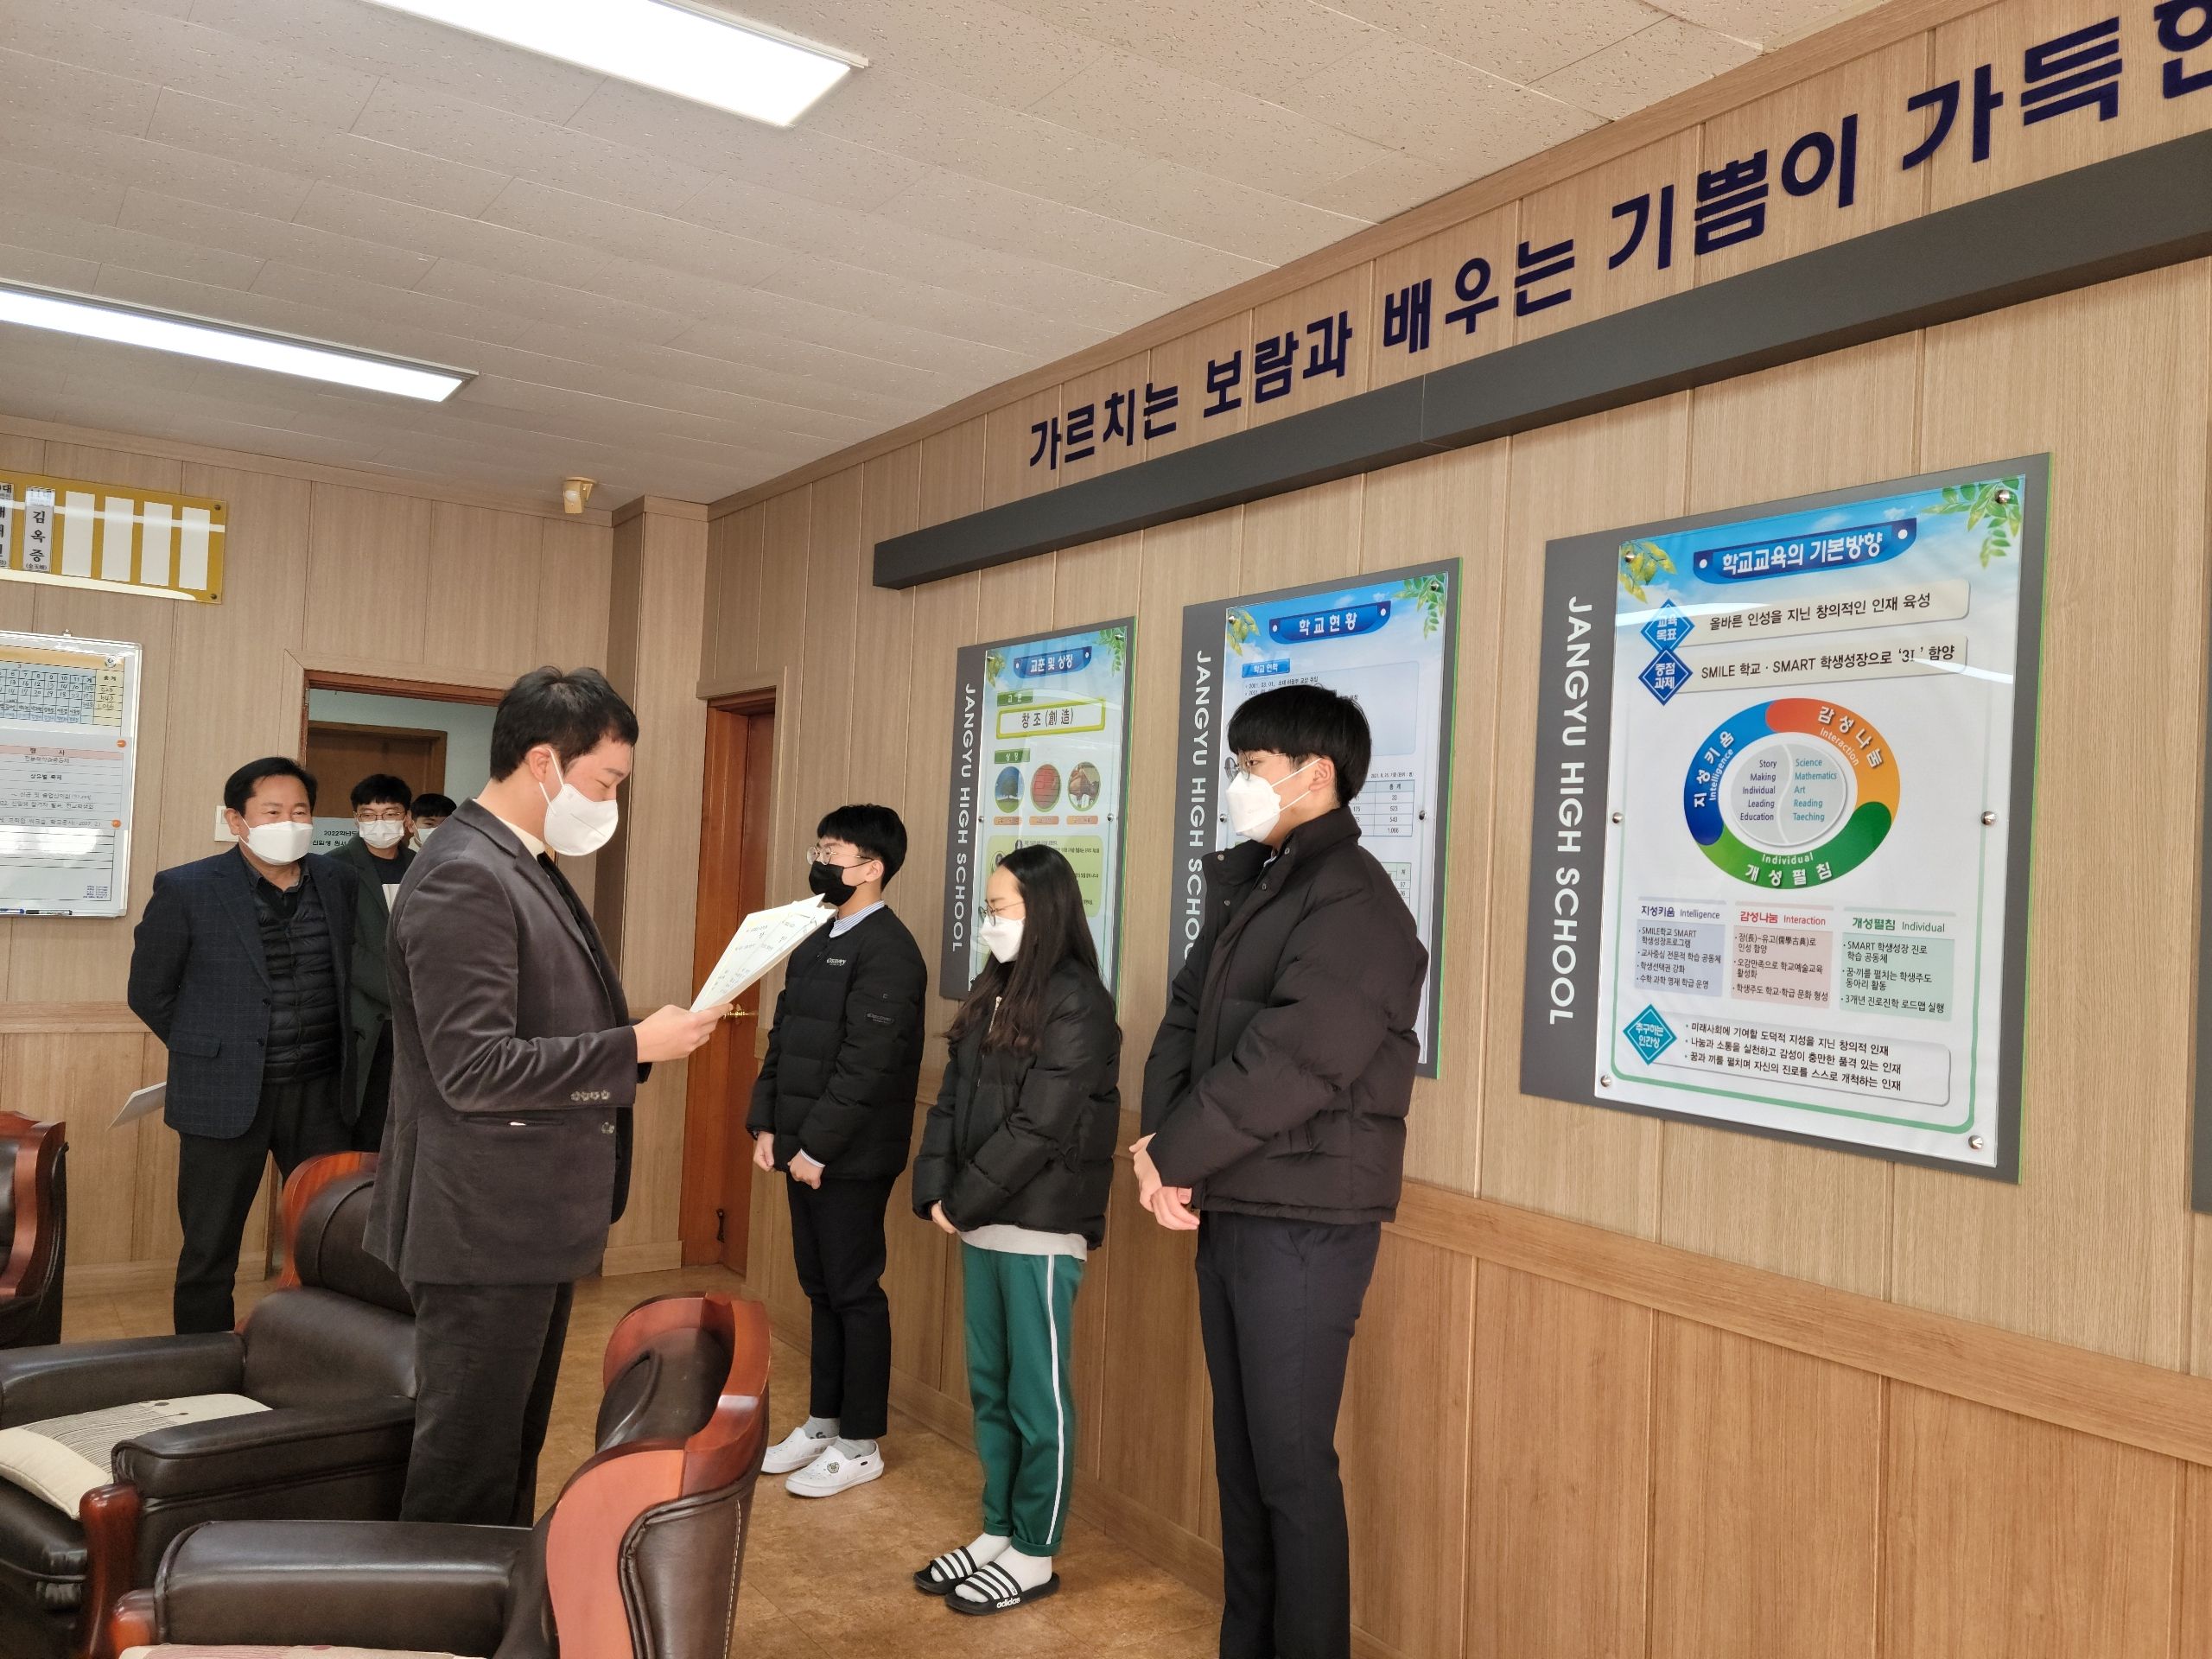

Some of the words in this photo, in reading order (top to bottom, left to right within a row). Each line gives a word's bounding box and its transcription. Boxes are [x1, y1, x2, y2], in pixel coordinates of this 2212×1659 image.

[1030, 383, 1178, 470] 가르치는
[1204, 310, 1352, 418] 보람과
[1383, 238, 1574, 353] 배우는
[1608, 114, 1858, 270] 기쁨이
[1722, 543, 1804, 575] 학교교육의
[1809, 531, 1883, 563] 기본방향
[1710, 614, 1743, 631] 올바른
[1747, 609, 1783, 626] 인성을
[1787, 607, 1811, 622] 지닌
[1816, 601, 1866, 620] 창의적인
[1872, 596, 1898, 613] 인재
[1903, 593, 1930, 609] 육성
[1299, 612, 1357, 636] 학교현황
[1656, 628, 1677, 641] 목표
[1048, 657, 1055, 671] 및
[1058, 653, 1073, 669] 상징
[1701, 665, 1735, 679] SMILE
[1739, 662, 1761, 677] 학교
[1772, 658, 1816, 673] SMART
[1821, 651, 1892, 670] 학생성장으로
[1929, 645, 1955, 661] 함양
[1562, 596, 1592, 747] JANGYU
[1656, 662, 1675, 677] 중점
[1654, 677, 1675, 690] 과제
[1192, 651, 1211, 766] JANGYU
[961, 683, 976, 779] JANGYU
[1818, 706, 1884, 768] 감성나눔
[1820, 728, 1859, 766] Interaction
[1694, 731, 1735, 808] 지성키움
[1759, 760, 1777, 769] Story
[1796, 758, 1823, 767] Science
[1709, 748, 1733, 801] Intelligence
[1750, 772, 1777, 782] Making
[1795, 772, 1837, 780] Mathematics
[1742, 785, 1776, 794] Individual
[1794, 785, 1805, 794] Art
[1557, 762, 1584, 853] HIGH
[1748, 799, 1775, 809] Leading
[1794, 799, 1823, 808] Reading
[957, 786, 970, 845] HIGH
[1189, 778, 1206, 848] HIGH
[1740, 812, 1774, 821] Education
[1793, 813, 1825, 823] Taeching
[1762, 852, 1814, 864] Individual
[1745, 862, 1832, 887] 개성펼침
[952, 854, 967, 952] SCHOOL
[1184, 858, 1202, 961] SCHO
[1641, 906, 1675, 918] 지성키움
[1680, 909, 1720, 919] Intelligence
[1740, 911, 1778, 924] 감성나눔
[1783, 915, 1826, 925] Interaction
[1642, 927, 1672, 936] SMILE학교
[1853, 918, 1896, 931] 개성펼침
[1902, 922, 1945, 932] Individual
[1549, 867, 1580, 1025] SCHOOL
[1642, 936, 1691, 948] 학생성장프로그램
[1738, 943, 1751, 953] 인성
[1754, 944, 1767, 954] 함양
[1847, 941, 1875, 950] SMART
[1878, 942, 1909, 954] 학생성장
[1911, 945, 1928, 955] 진로
[1641, 950, 1665, 959] 교사중심
[1667, 950, 1686, 960] 전문적
[1688, 952, 1700, 962] 학습
[1701, 954, 1721, 964] 공동체
[1847, 951, 1862, 962] 학습
[1864, 952, 1888, 963] 공동체
[1641, 962, 1671, 973] 학생선택권
[1673, 964, 1685, 974] 강화
[1738, 958, 1778, 969] 오감만족으로
[1780, 961, 1823, 974] 학교예술교육
[1653, 976, 1666, 984] 과학
[1737, 968, 1758, 979] 활성화
[1873, 969, 1897, 981] 펼치는
[1899, 971, 1932, 983] 학생주도
[1846, 978, 1869, 989] 동아리
[1872, 980, 1887, 991] 활동
[1737, 983, 1764, 994] 학생주도
[1797, 989, 1812, 1001] 문화
[1814, 990, 1828, 1001] 형성
[1845, 995, 1866, 1006] 3개년
[1868, 996, 1899, 1008] 진로진학
[1901, 1000, 1925, 1012] 로드맵
[1928, 1001, 1944, 1014] 실행
[1691, 1022, 1731, 1035] 미래사회에
[1733, 1027, 1758, 1038] 기여할
[1760, 1031, 1786, 1043] 도덕적
[1789, 1034, 1815, 1046] 지성을
[1818, 1038, 1835, 1050] 지닌
[1840, 1039, 1867, 1053] 창의적
[1870, 1044, 1889, 1056] 인재
[1691, 1038, 1714, 1049] 나눔과
[1717, 1039, 1740, 1052] 소통을
[1744, 1044, 1777, 1056] 실천하고
[1779, 1048, 1805, 1062] 감성이
[1808, 1052, 1835, 1065] 충만한
[1839, 1057, 1857, 1069] 품격
[1860, 1059, 1878, 1071] 있는
[1882, 1062, 1901, 1074] 인재
[1690, 1052, 1706, 1063] 꿈과
[1708, 1055, 1724, 1066] 끼를
[1727, 1056, 1751, 1070] 펼치며
[1753, 1060, 1779, 1073] 자신의
[1782, 1065, 1808, 1077] 진로를
[1811, 1069, 1839, 1082] 스스로
[1841, 1073, 1878, 1088] 개척하는
[1882, 1078, 1901, 1091] 인재
[997, 1598, 1020, 1608] adidas
